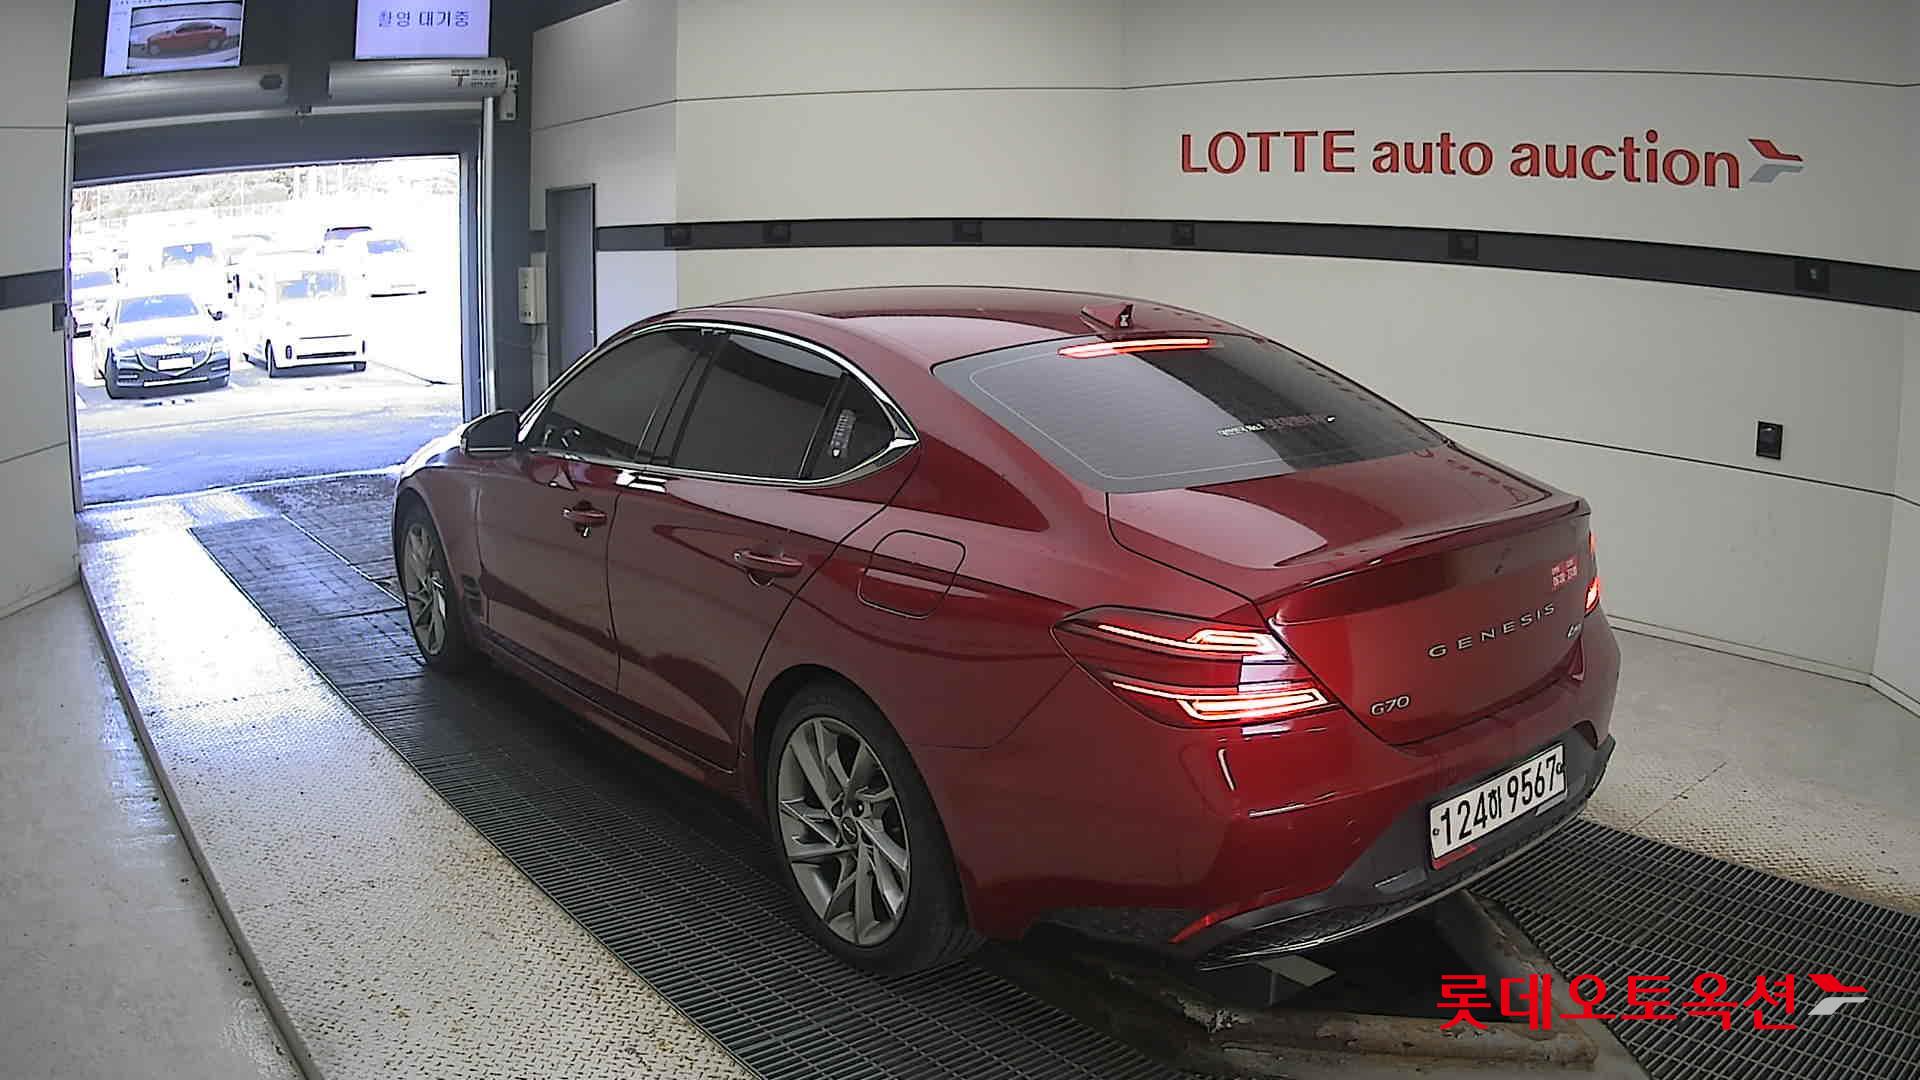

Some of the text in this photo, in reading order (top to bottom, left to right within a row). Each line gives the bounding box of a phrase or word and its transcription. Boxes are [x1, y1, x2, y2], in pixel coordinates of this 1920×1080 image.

[1180, 129, 1741, 189] LOTTE auto auction
[1427, 601, 1555, 658] GENESIS
[1370, 694, 1411, 717] G70
[1440, 754, 1557, 846] 124하 9567
